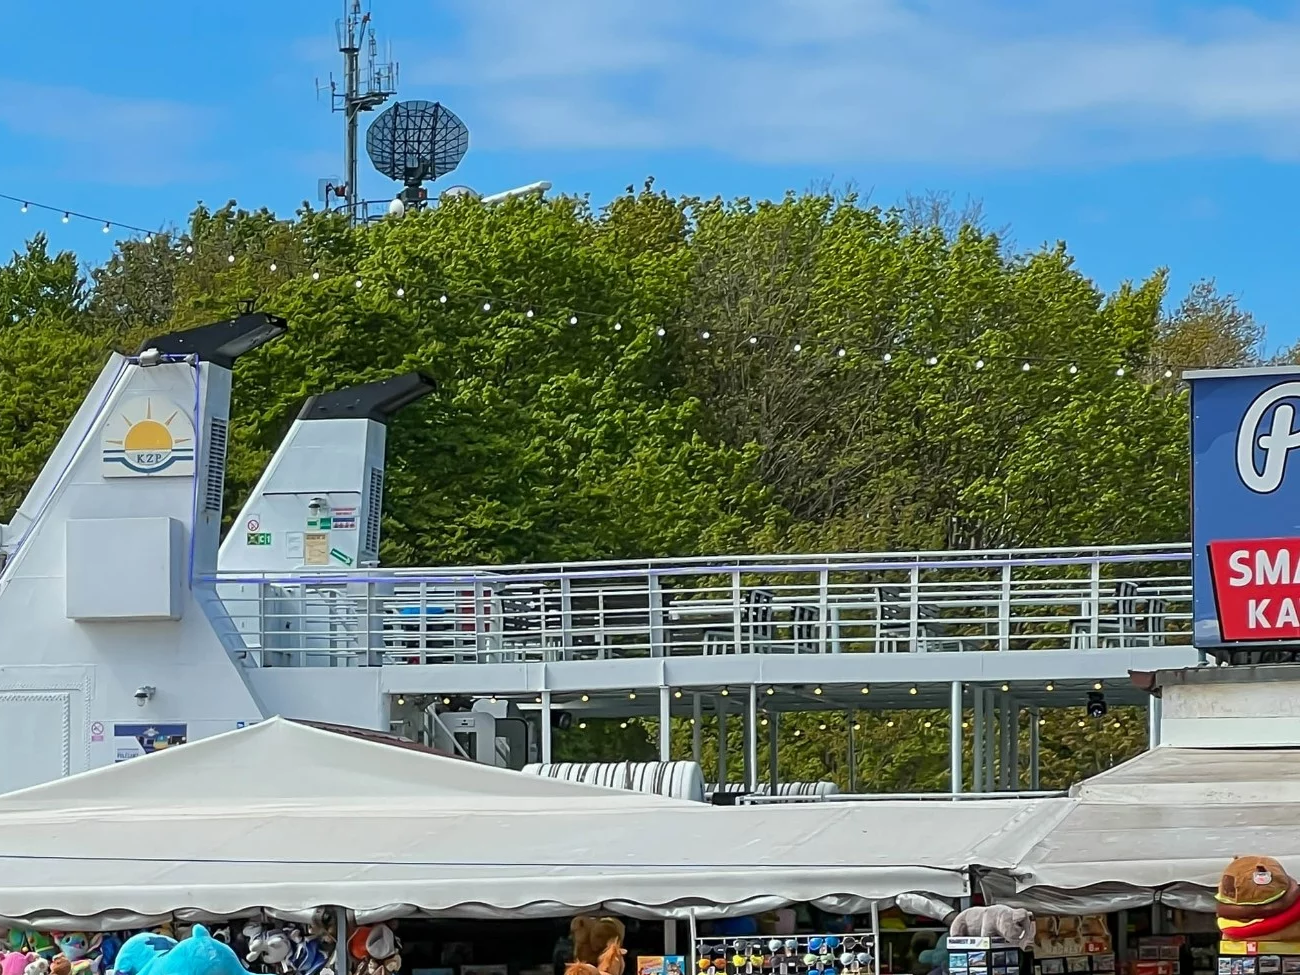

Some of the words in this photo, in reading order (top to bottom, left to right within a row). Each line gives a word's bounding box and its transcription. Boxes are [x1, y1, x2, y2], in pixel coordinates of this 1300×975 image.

[136, 453, 162, 464] KZP
[1228, 548, 1300, 587] SM
[1248, 597, 1300, 629] KA
